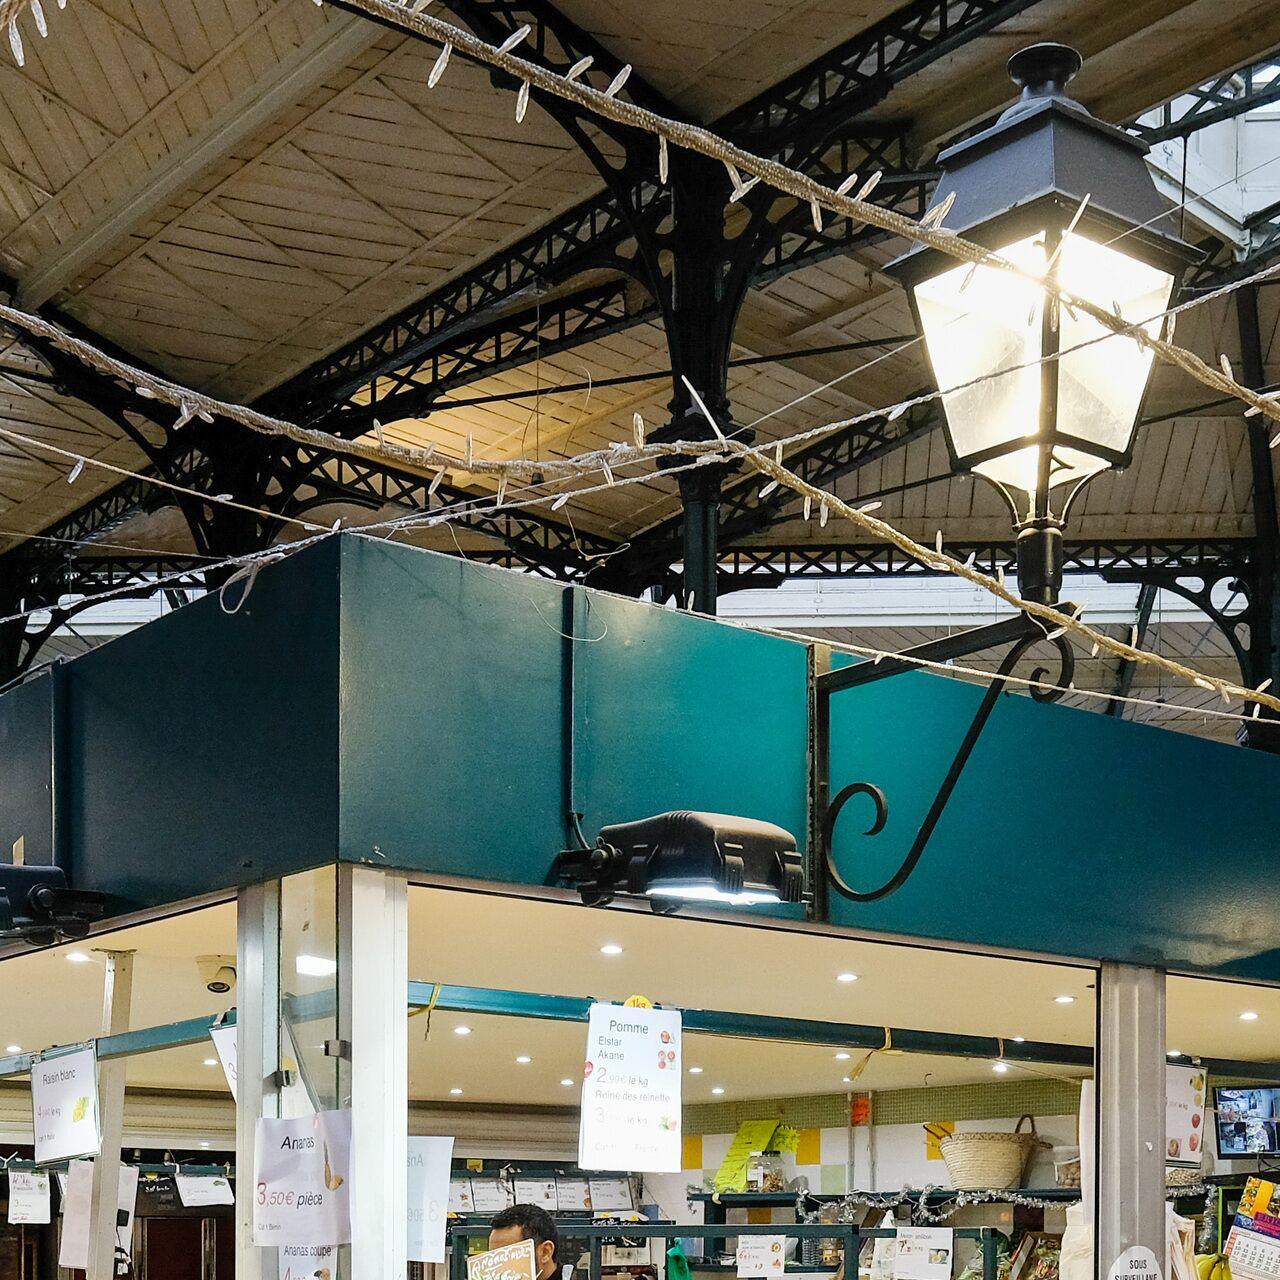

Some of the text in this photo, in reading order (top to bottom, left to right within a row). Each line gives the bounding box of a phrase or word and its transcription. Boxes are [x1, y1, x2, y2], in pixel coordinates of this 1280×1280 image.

[609, 1020, 649, 1035] Pomme
[598, 1036, 622, 1046] Elstar
[598, 1050, 625, 1060] Akane
[42, 1069, 76, 1086] Raisin blanc
[629, 1075, 636, 1084] le
[638, 1076, 649, 1088] kg
[595, 1090, 620, 1100] Reine
[623, 1092, 637, 1102] des
[280, 1135, 315, 1151] Ananas
[257, 1182, 323, 1209] 3,50€ pièce
[284, 1245, 309, 1257] Ananas
[1129, 1259, 1147, 1270] SOUS
